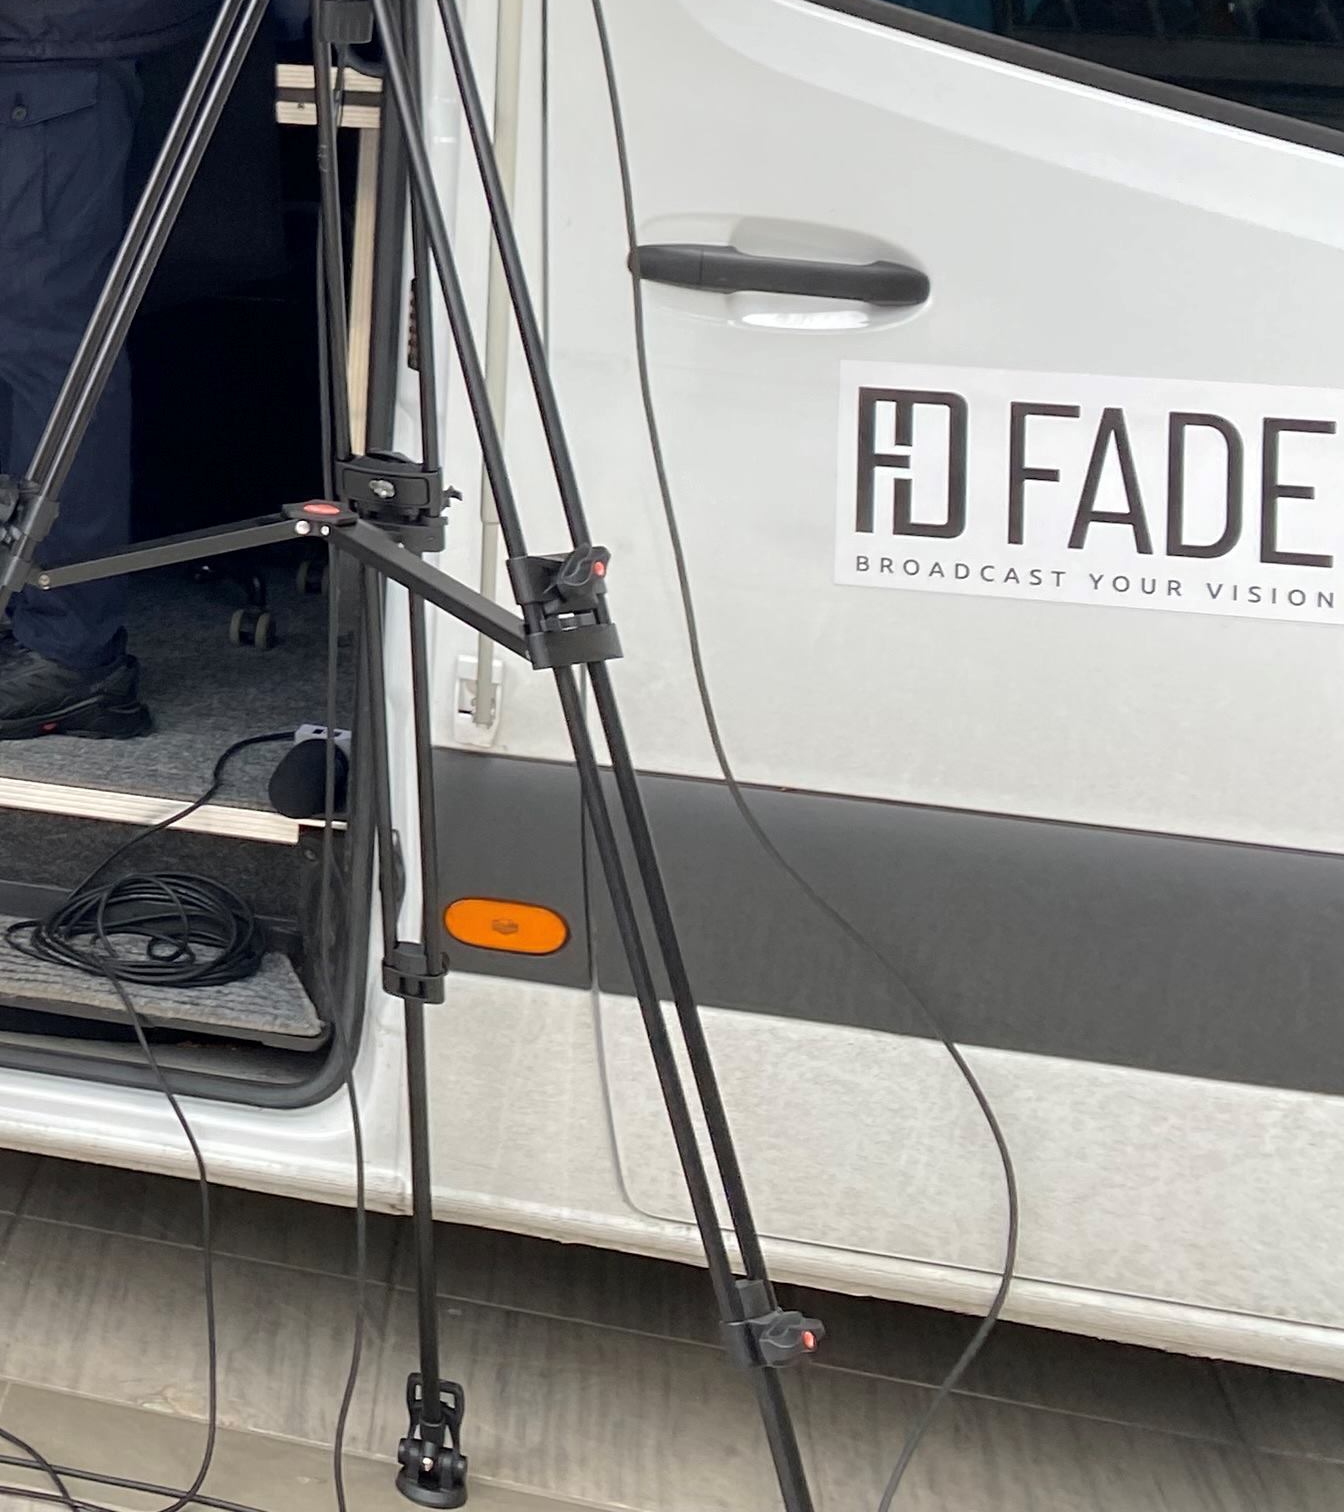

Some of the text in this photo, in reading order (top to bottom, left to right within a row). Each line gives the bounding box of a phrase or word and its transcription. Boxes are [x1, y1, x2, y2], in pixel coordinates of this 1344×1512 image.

[1007, 401, 1338, 569] FADE
[855, 554, 1335, 609] BROADCAST YOUR VISION
